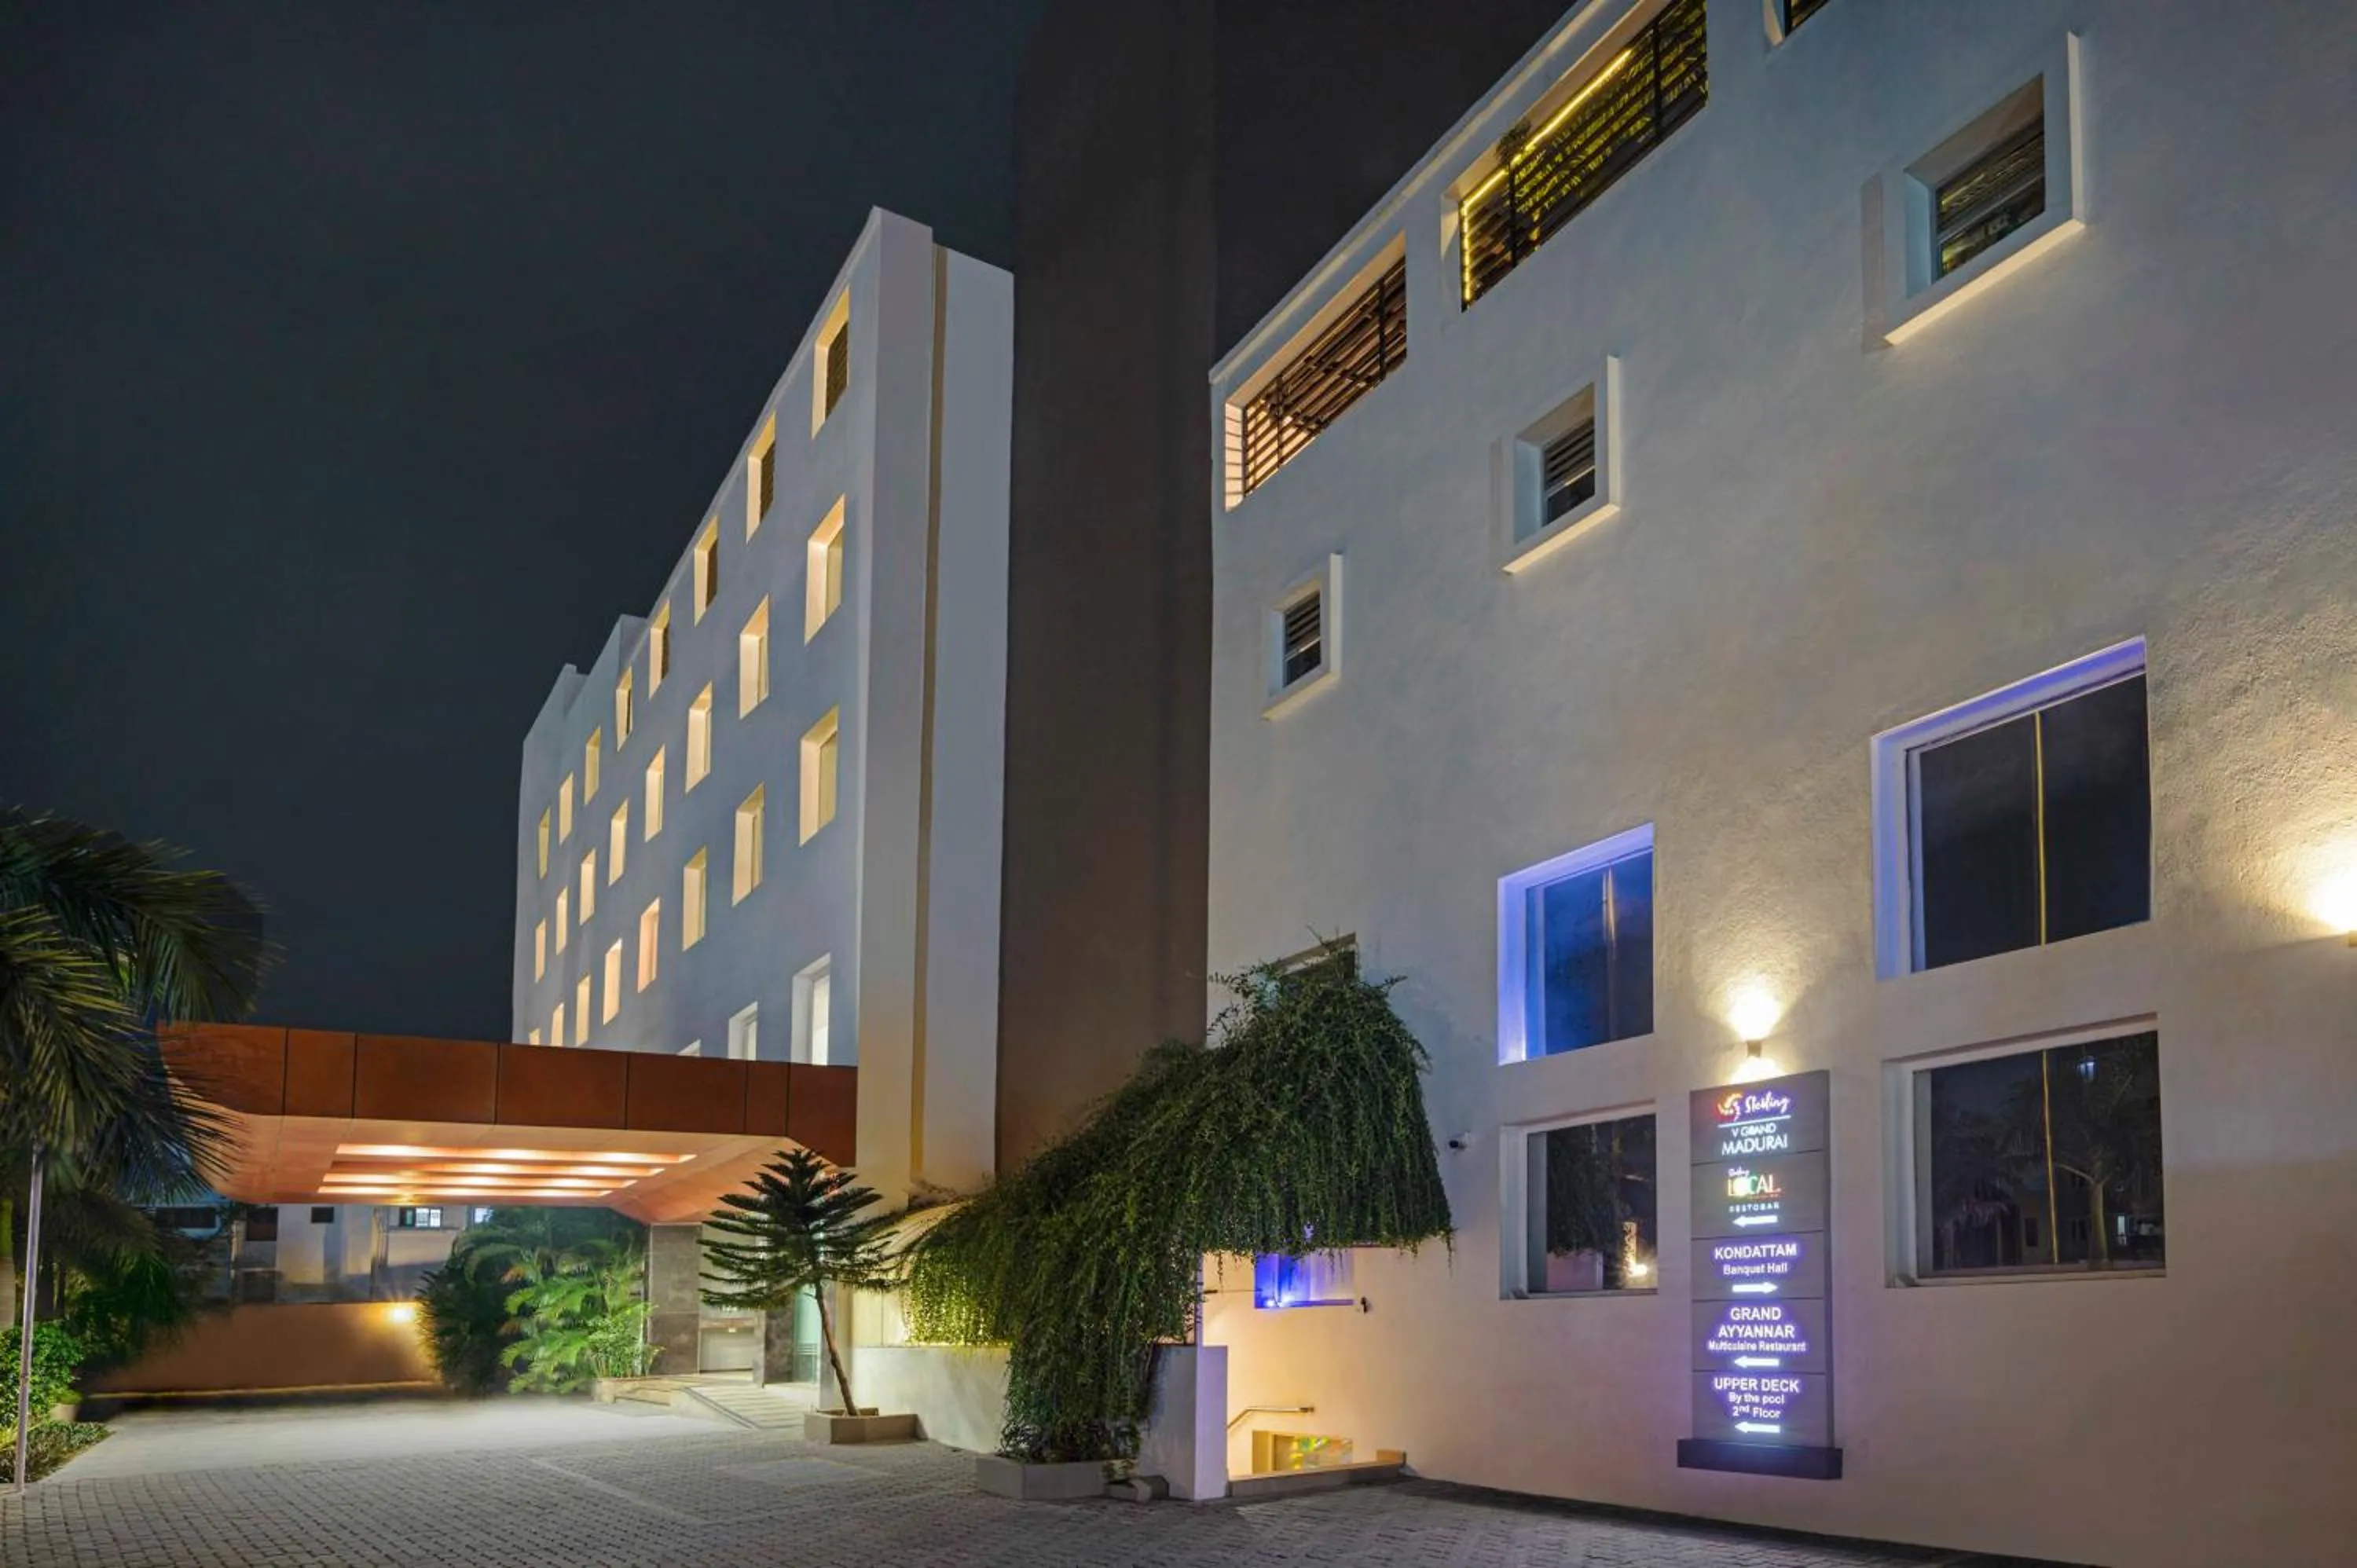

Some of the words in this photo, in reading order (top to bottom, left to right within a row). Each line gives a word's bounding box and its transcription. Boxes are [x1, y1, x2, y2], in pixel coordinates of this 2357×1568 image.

[1731, 1127, 1739, 1137] V
[1739, 1123, 1776, 1136] GRAND
[1721, 1134, 1788, 1156] MADURAI
[1714, 1243, 1798, 1260] KONDATTAM
[1723, 1264, 1765, 1276] Banquet
[1766, 1262, 1788, 1273] Hall
[1730, 1306, 1782, 1321] GRAND
[1717, 1324, 1794, 1339] AYYANNAR
[1708, 1340, 1757, 1351] Multicuisine
[1758, 1340, 1806, 1352] Restaurant
[1714, 1377, 1758, 1390] UPPER
[1761, 1379, 1800, 1393] DECK
[1728, 1392, 1741, 1404] By
[1743, 1393, 1759, 1403] the
[1762, 1394, 1785, 1406] pool
[1752, 1407, 1781, 1418] Floor
